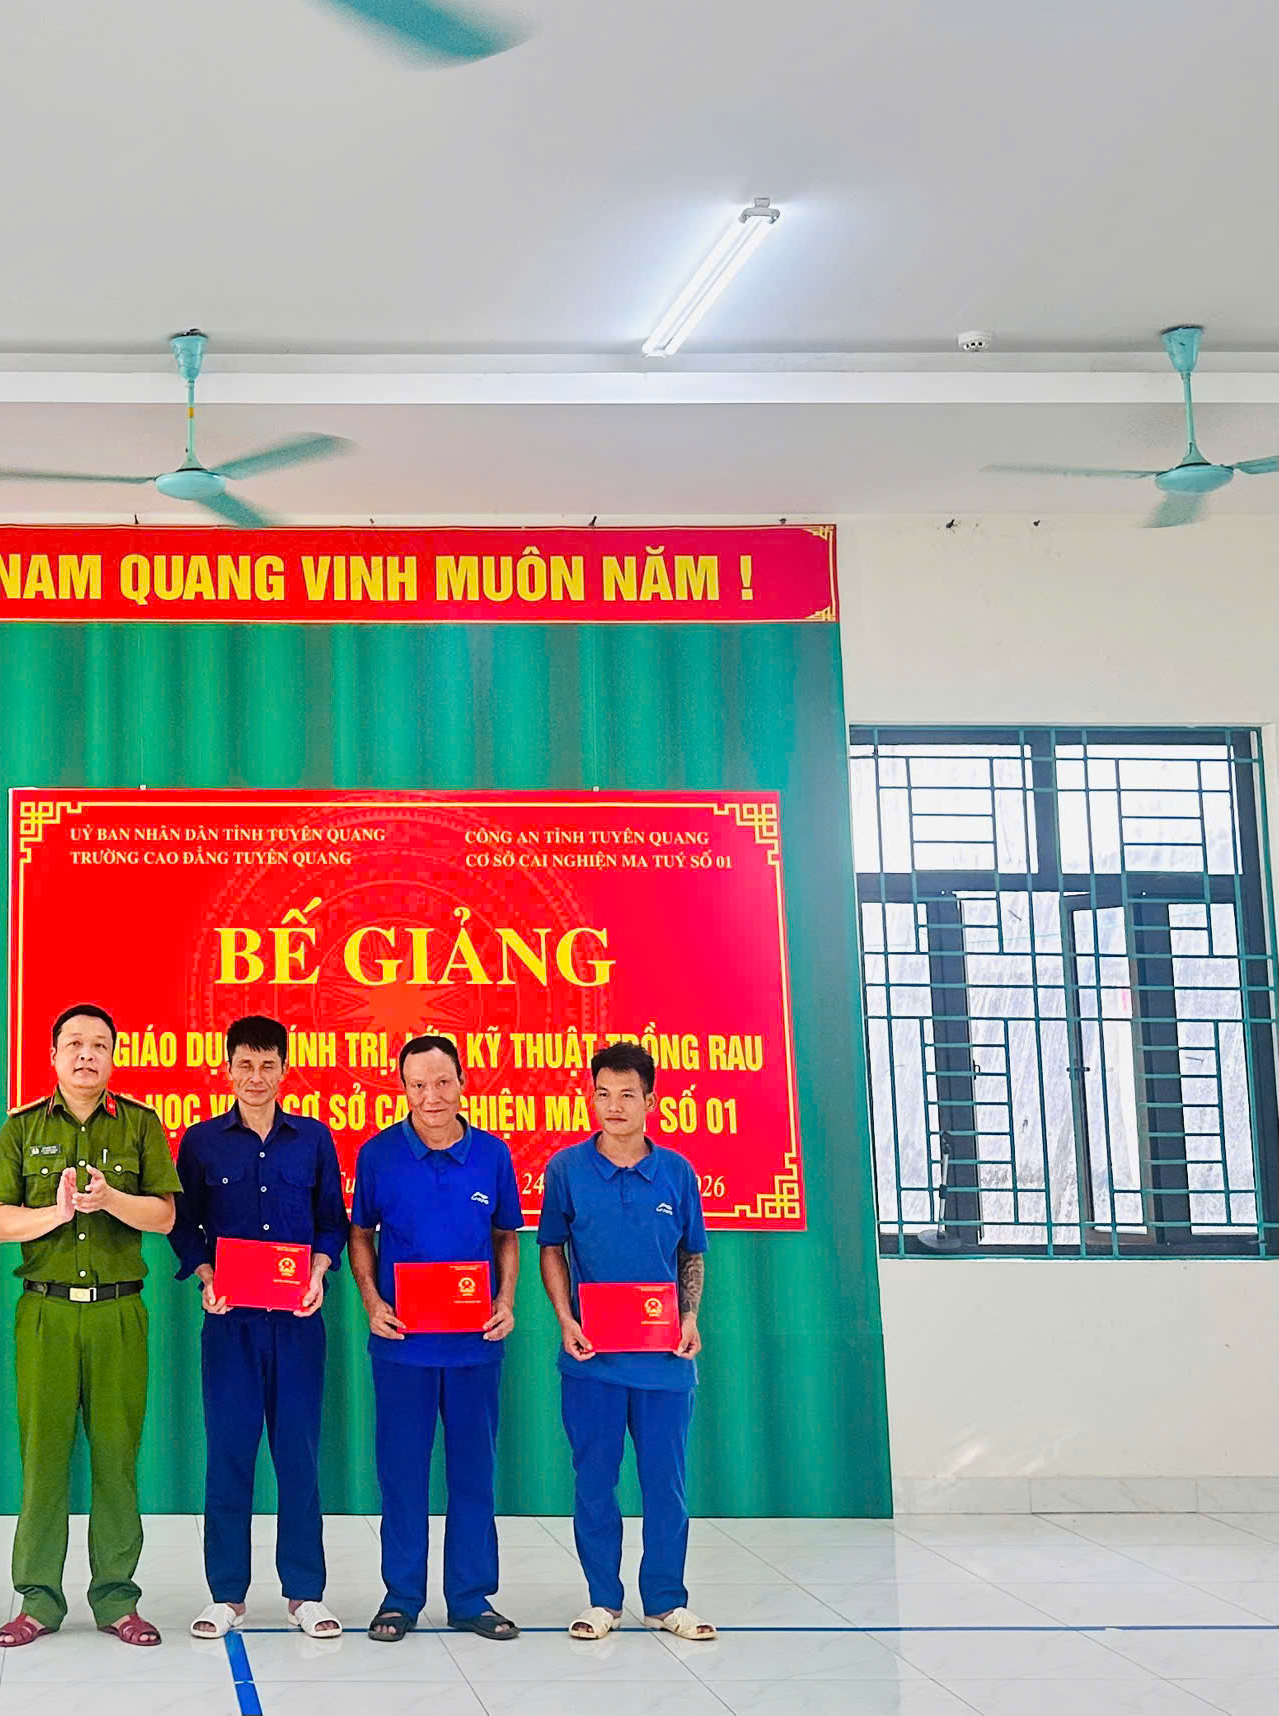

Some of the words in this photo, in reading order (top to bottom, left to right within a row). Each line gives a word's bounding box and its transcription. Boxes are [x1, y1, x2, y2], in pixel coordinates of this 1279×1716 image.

[121, 554, 285, 605] QUANG
[301, 555, 417, 601] VINH
[435, 546, 585, 601] MUÔN
[602, 545, 719, 601] NĂM
[71, 825, 93, 841] UỶ
[97, 828, 130, 841] BAN
[134, 826, 181, 841] NHÂN
[185, 826, 219, 841] DÂN
[223, 825, 264, 841] TỈNH
[268, 826, 323, 841] TUYÊN
[326, 828, 386, 843] QUANG
[465, 829, 513, 844] CÔNG
[517, 831, 540, 844] AN
[544, 828, 584, 844] TỈNH
[589, 829, 645, 844] TUYÊN
[649, 831, 710, 846] QUANG
[71, 847, 140, 864] TRƯỜNG
[144, 851, 179, 865] CAO
[233, 848, 288, 865] TUYÊN
[292, 851, 352, 867] QUANG
[465, 853, 490, 868] CƠ
[493, 852, 516, 868] SỞ
[519, 854, 549, 868] CAI
[552, 852, 617, 870] NGHIỆN
[621, 855, 648, 868] MA
[652, 851, 685, 869] TUÝ
[690, 850, 713, 869] SỐ
[716, 856, 732, 869] 01
[214, 897, 322, 984] BẾ
[344, 906, 616, 986] GIẢNG
[113, 1025, 177, 1067] GIÁO
[186, 1031, 228, 1075] DỤ
[345, 1032, 397, 1075] TRỊ,
[466, 1026, 503, 1068] KỸ
[515, 1026, 598, 1077] THUẬT
[709, 1034, 763, 1072] RAU
[329, 1082, 367, 1131] SỞ
[660, 1083, 698, 1133] SỐ
[707, 1098, 737, 1135] 01
